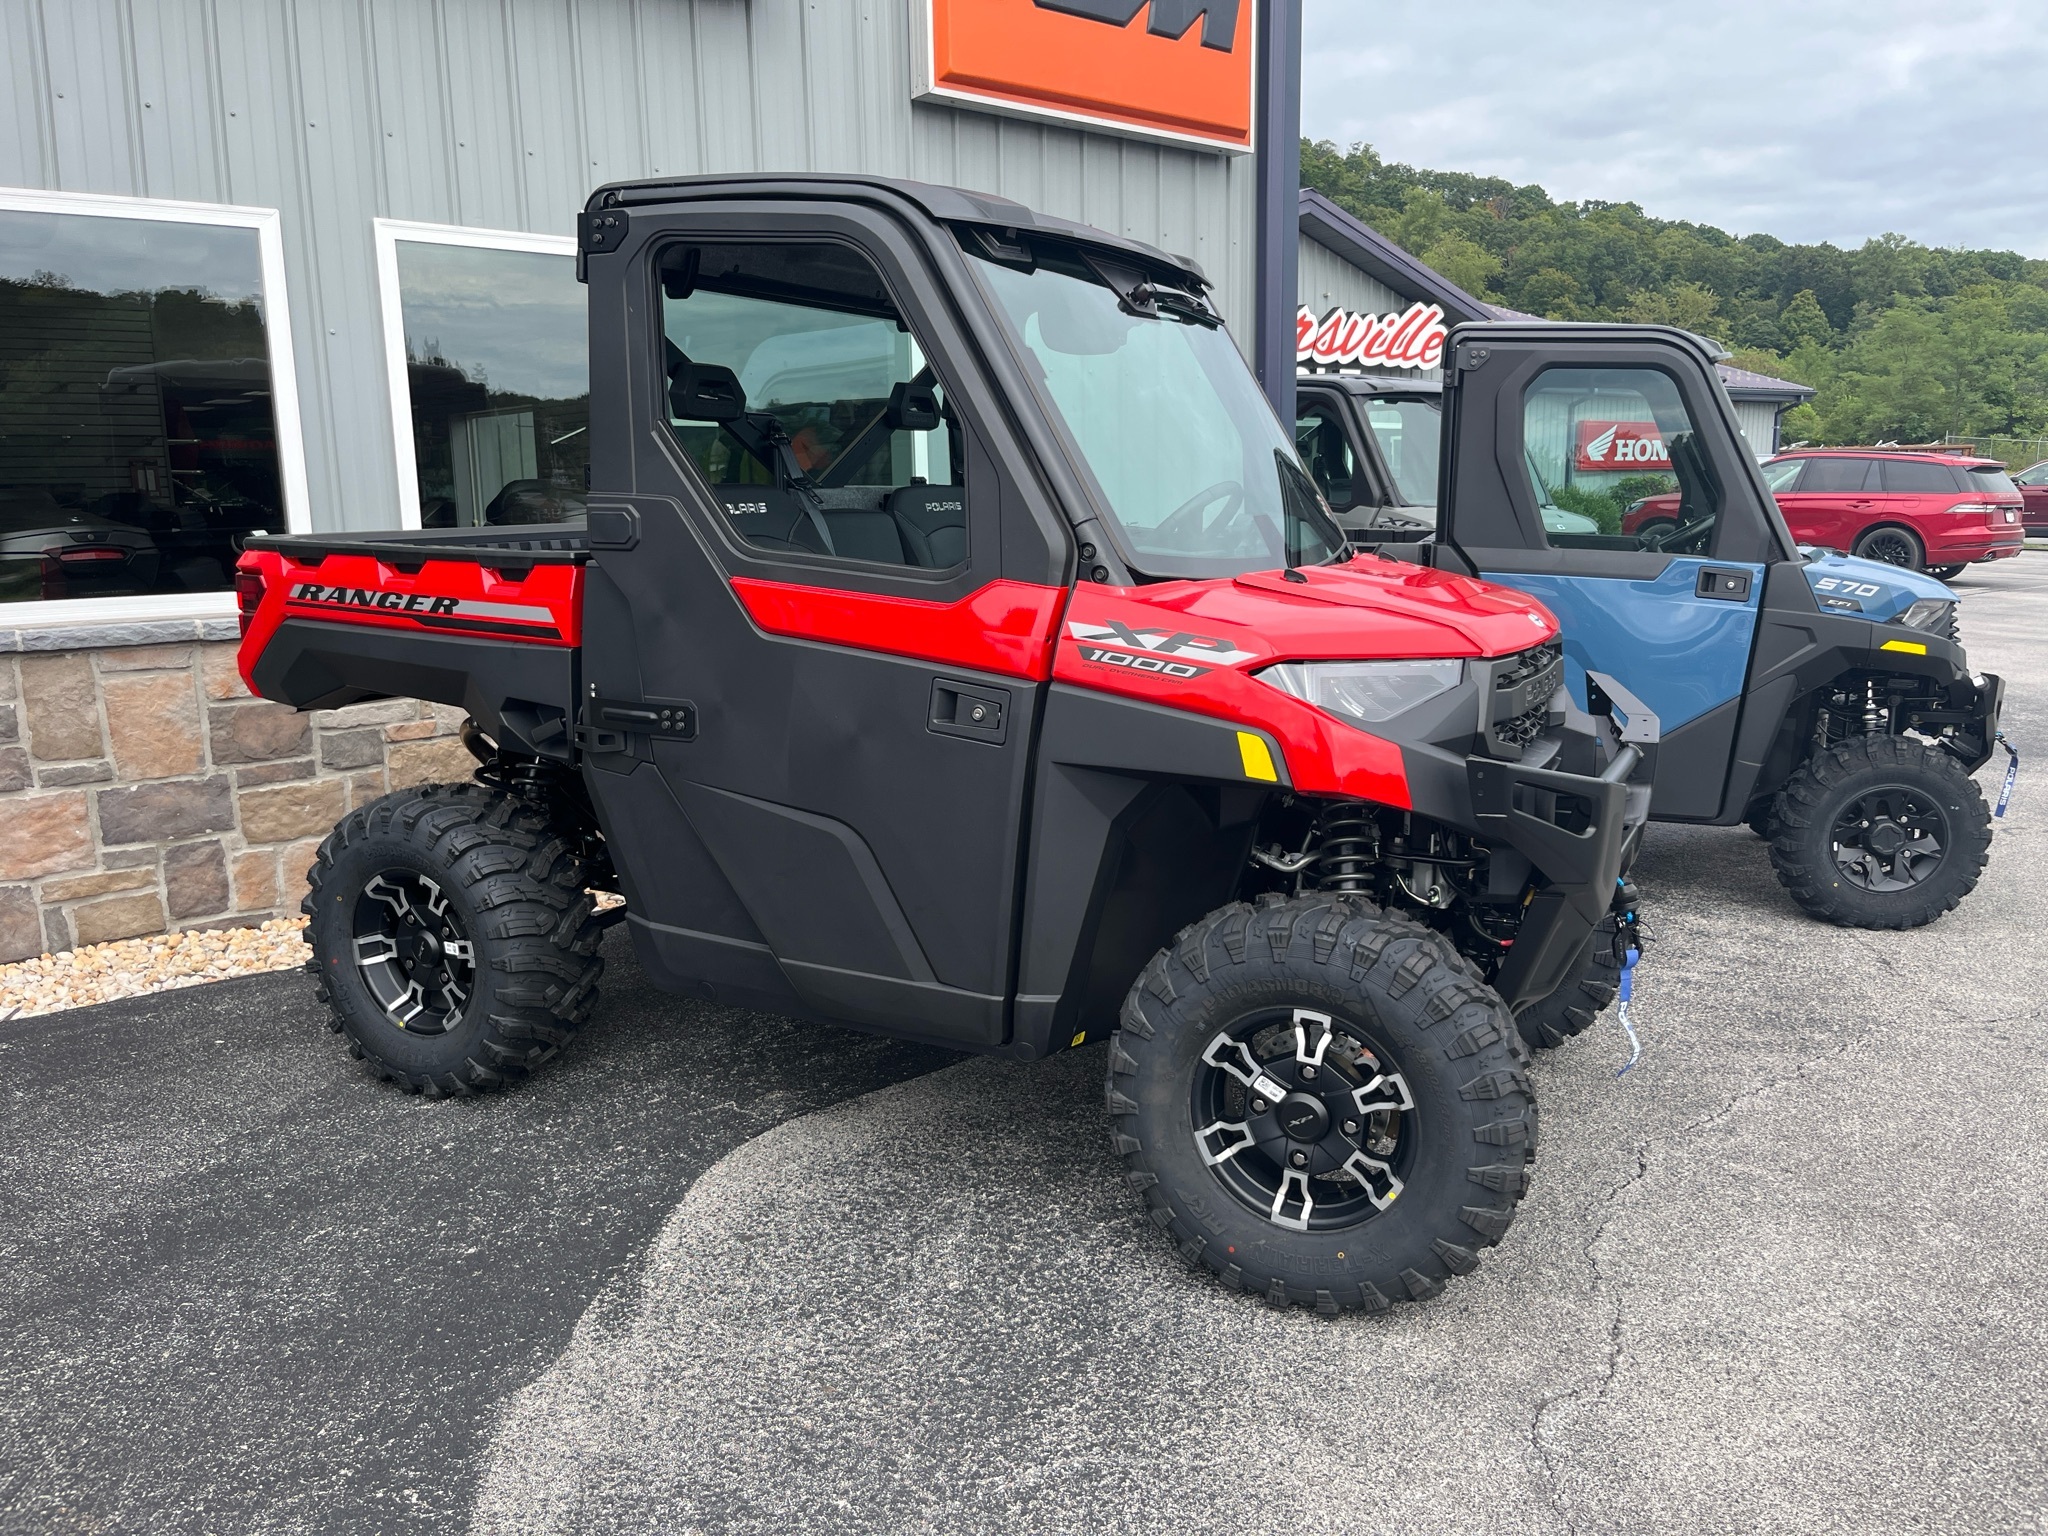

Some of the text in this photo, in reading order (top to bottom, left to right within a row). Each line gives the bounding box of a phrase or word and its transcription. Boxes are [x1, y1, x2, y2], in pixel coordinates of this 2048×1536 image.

[925, 501, 962, 513] POLARIS
[295, 583, 460, 616] RANGER
[1814, 577, 1880, 597] 570
[1826, 599, 1852, 607] EFI
[1078, 618, 1238, 654] XP
[1082, 663, 1183, 685] DUAL OVERHEAD CAM
[1089, 649, 1198, 678] 1000
[1999, 766, 2016, 806] POLARIS
[1249, 1243, 1391, 1275] X-TERRAIN
